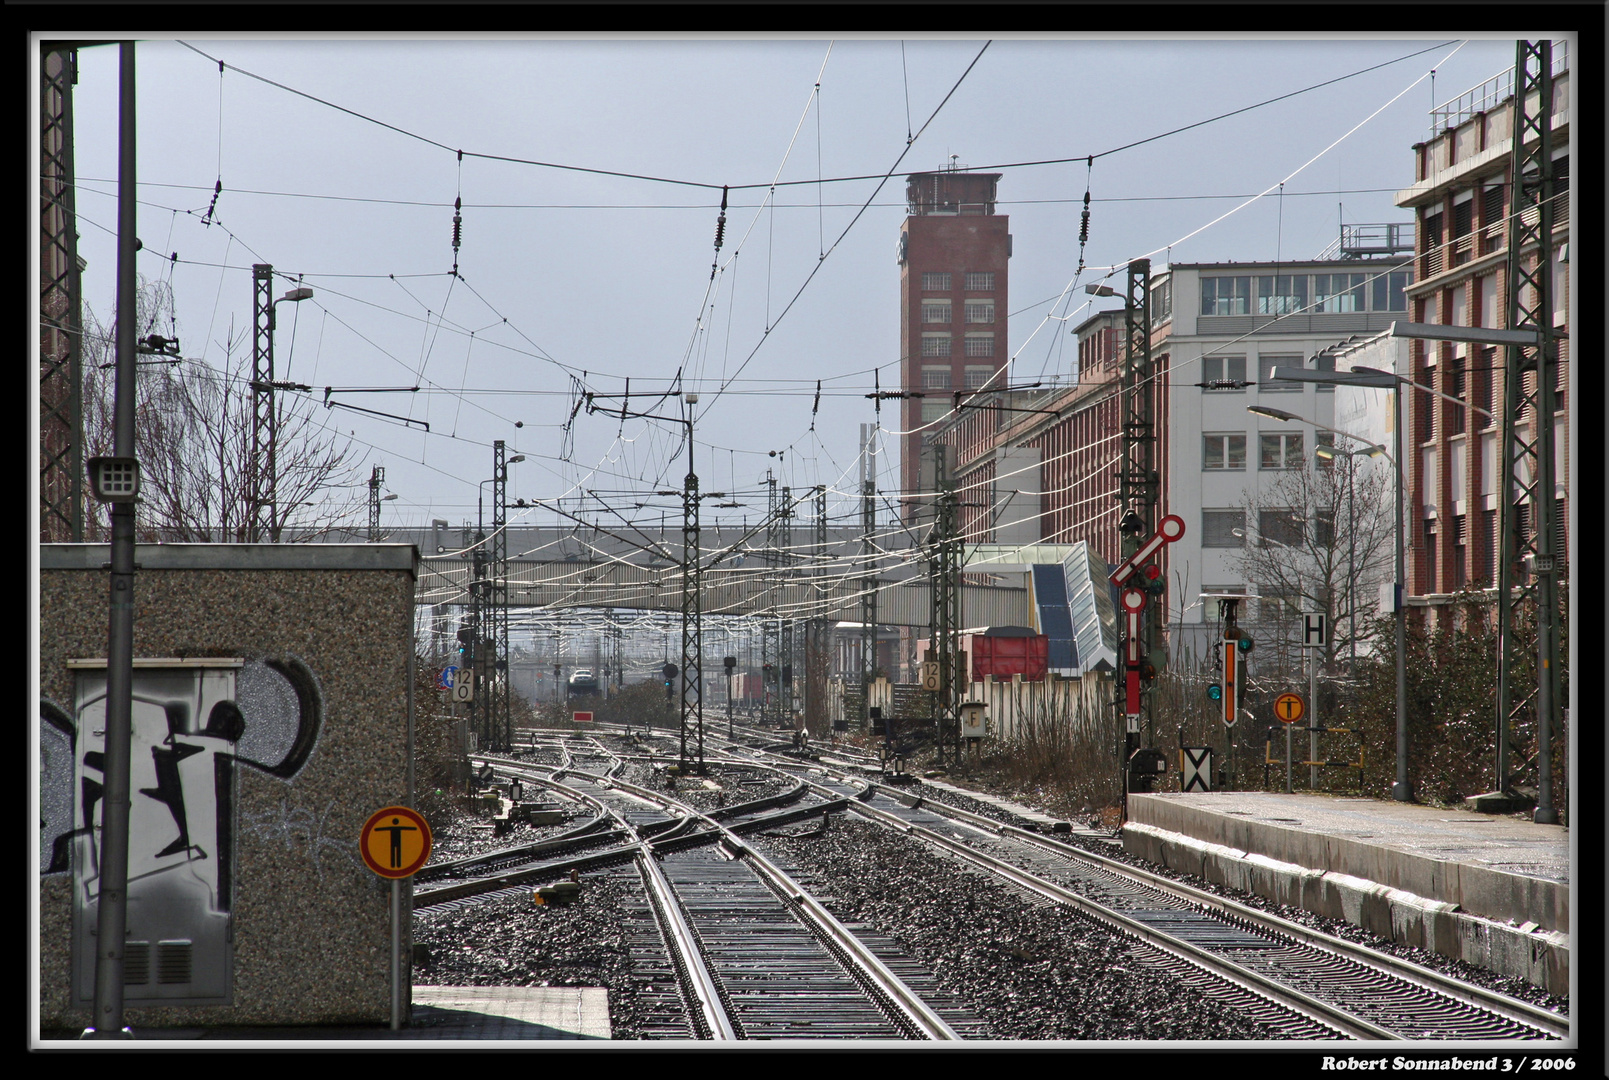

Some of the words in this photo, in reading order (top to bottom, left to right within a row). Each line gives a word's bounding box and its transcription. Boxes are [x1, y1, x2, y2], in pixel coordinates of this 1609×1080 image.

[1305, 615, 1324, 644] H
[925, 663, 938, 676] 12
[456, 670, 471, 684] 12
[927, 676, 936, 689] 0
[458, 685, 469, 699] 0
[970, 711, 977, 726] F
[1127, 716, 1139, 730] T1
